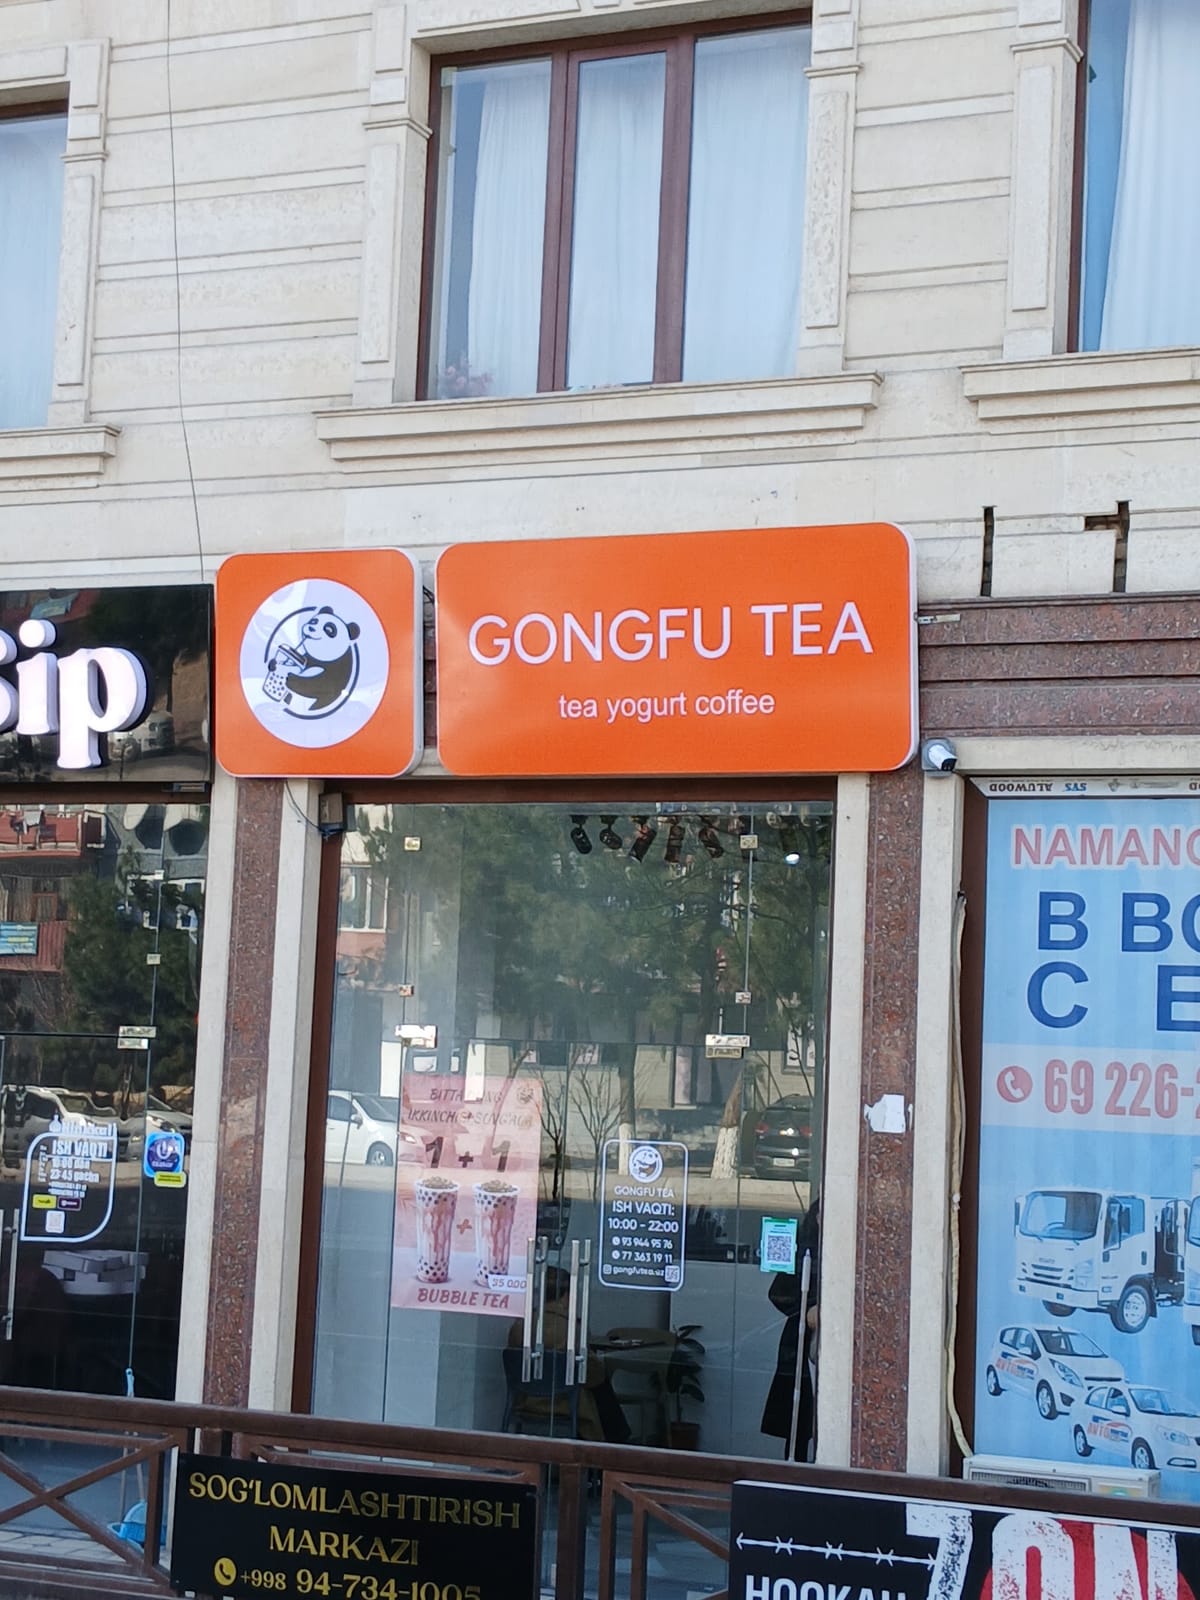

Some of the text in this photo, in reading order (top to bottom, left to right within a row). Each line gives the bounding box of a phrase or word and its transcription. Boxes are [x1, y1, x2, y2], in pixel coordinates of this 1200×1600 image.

[467, 602, 874, 666] GONGFU TEA
[558, 689, 775, 724] tea yogurt coffee
[989, 782, 1053, 792] ALUWOOD
[1037, 890, 1089, 951] B
[1026, 960, 1089, 1029] C
[1044, 1058, 1200, 1120] 69 226-
[425, 1136, 443, 1169] 1
[491, 1140, 511, 1173] 1
[612, 1200, 675, 1216] ISH VAQTI:
[614, 1185, 675, 1198] GONGFU TEA
[607, 1217, 638, 1230] 10:00
[647, 1220, 680, 1233] 22:00
[621, 1251, 633, 1261] 77
[417, 1287, 510, 1309] BUBBLE TEA
[188, 1471, 521, 1530] SOG'LOMLASHTIRISH
[269, 1525, 419, 1566] MARKAZI
[240, 1568, 287, 1591] +998
